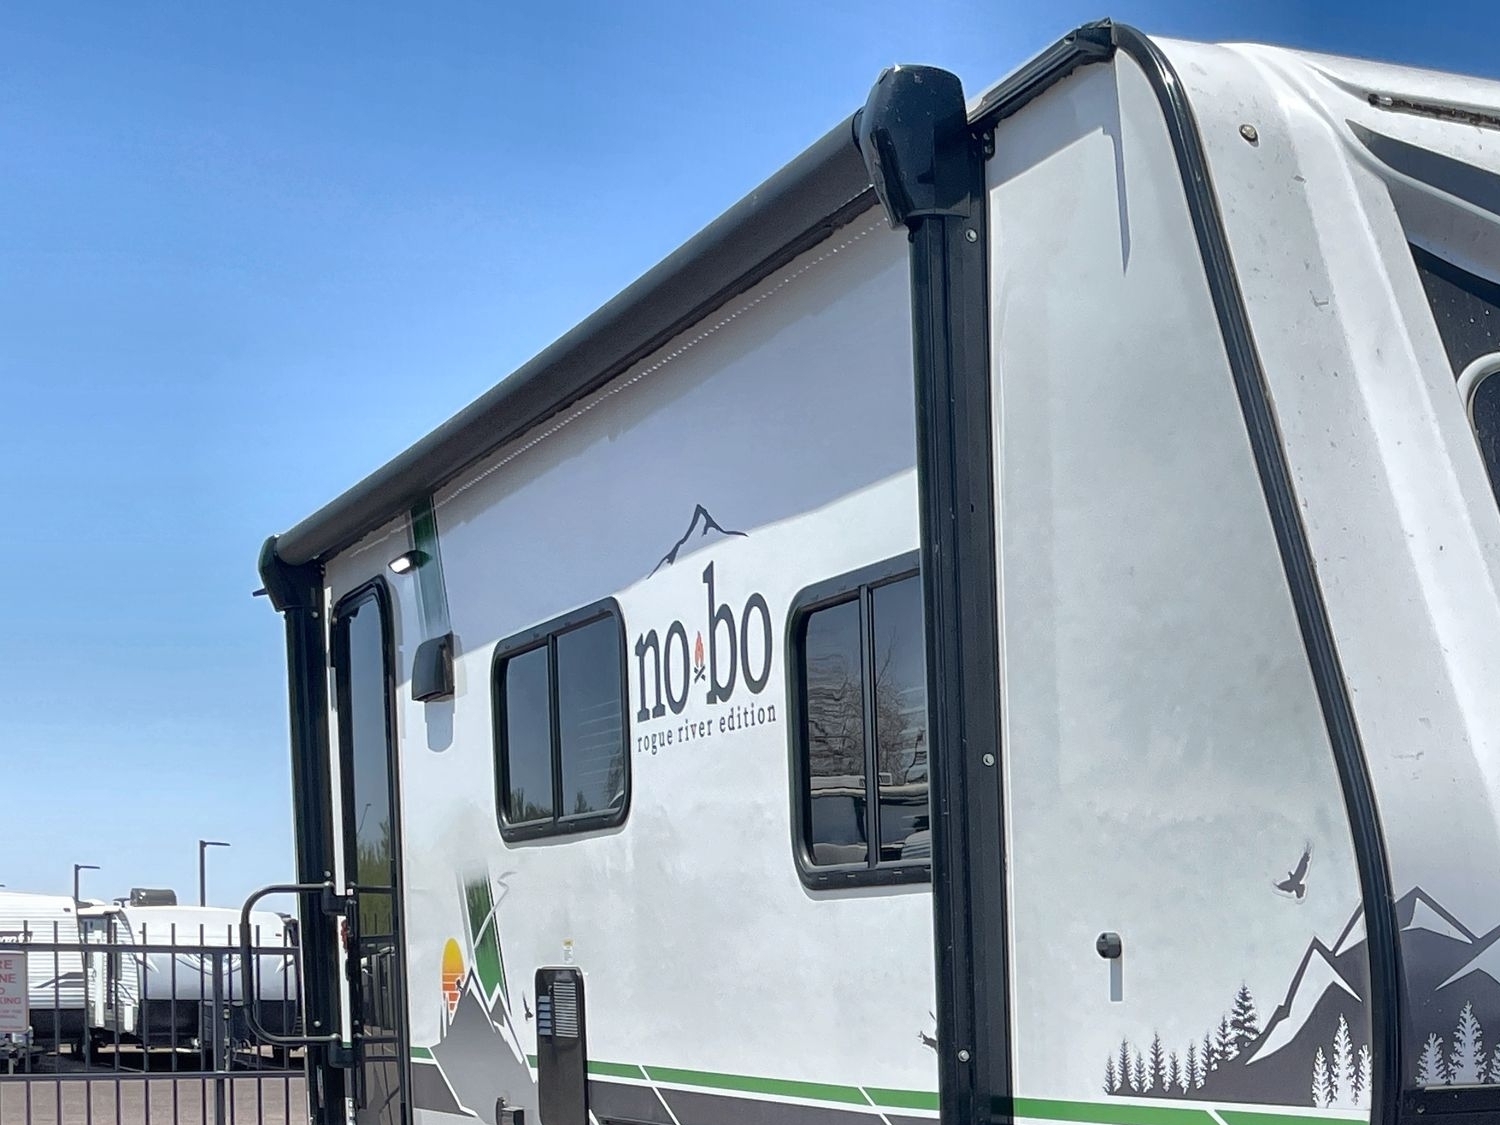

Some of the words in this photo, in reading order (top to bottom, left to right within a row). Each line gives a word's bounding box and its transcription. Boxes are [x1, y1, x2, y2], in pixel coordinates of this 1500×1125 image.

[637, 729, 673, 755] rogue
[678, 719, 713, 742] river
[719, 702, 777, 733] edition
